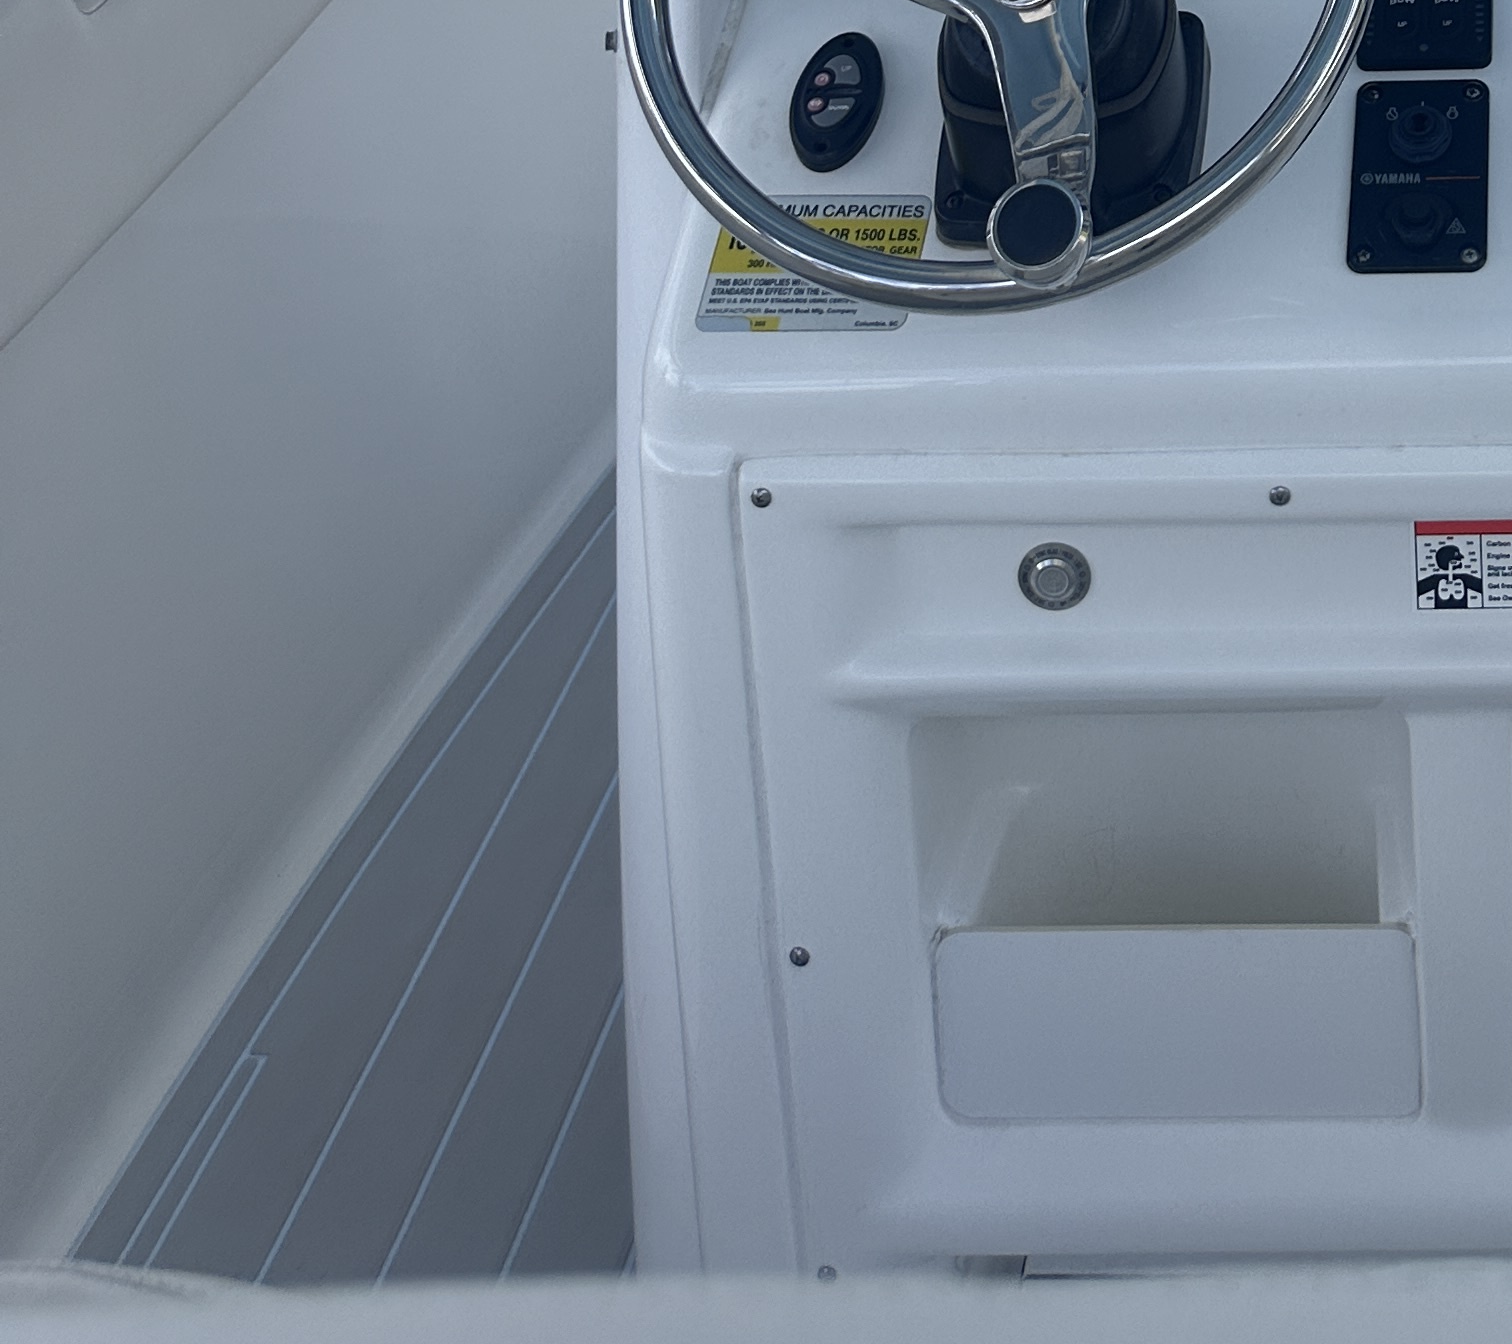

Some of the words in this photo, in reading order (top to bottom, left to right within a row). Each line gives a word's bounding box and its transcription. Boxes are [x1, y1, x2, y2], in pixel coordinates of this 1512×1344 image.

[1397, 20, 1408, 28] UP
[1442, 19, 1453, 27] UP
[1374, 173, 1421, 184] YAMAHA
[823, 204, 925, 218] CAPACITIES
[855, 229, 885, 241] 1500
[889, 228, 921, 242] LBS.
[890, 245, 917, 255] GEAR
[715, 278, 731, 286] THIS
[732, 278, 752, 286] BOAT
[753, 278, 791, 286] COMPLIES
[711, 288, 755, 296] STANDARDS
[765, 287, 793, 295] EFFECT
[794, 287, 805, 295] ON
[806, 287, 821, 295] THE
[1487, 552, 1510, 560] Engine
